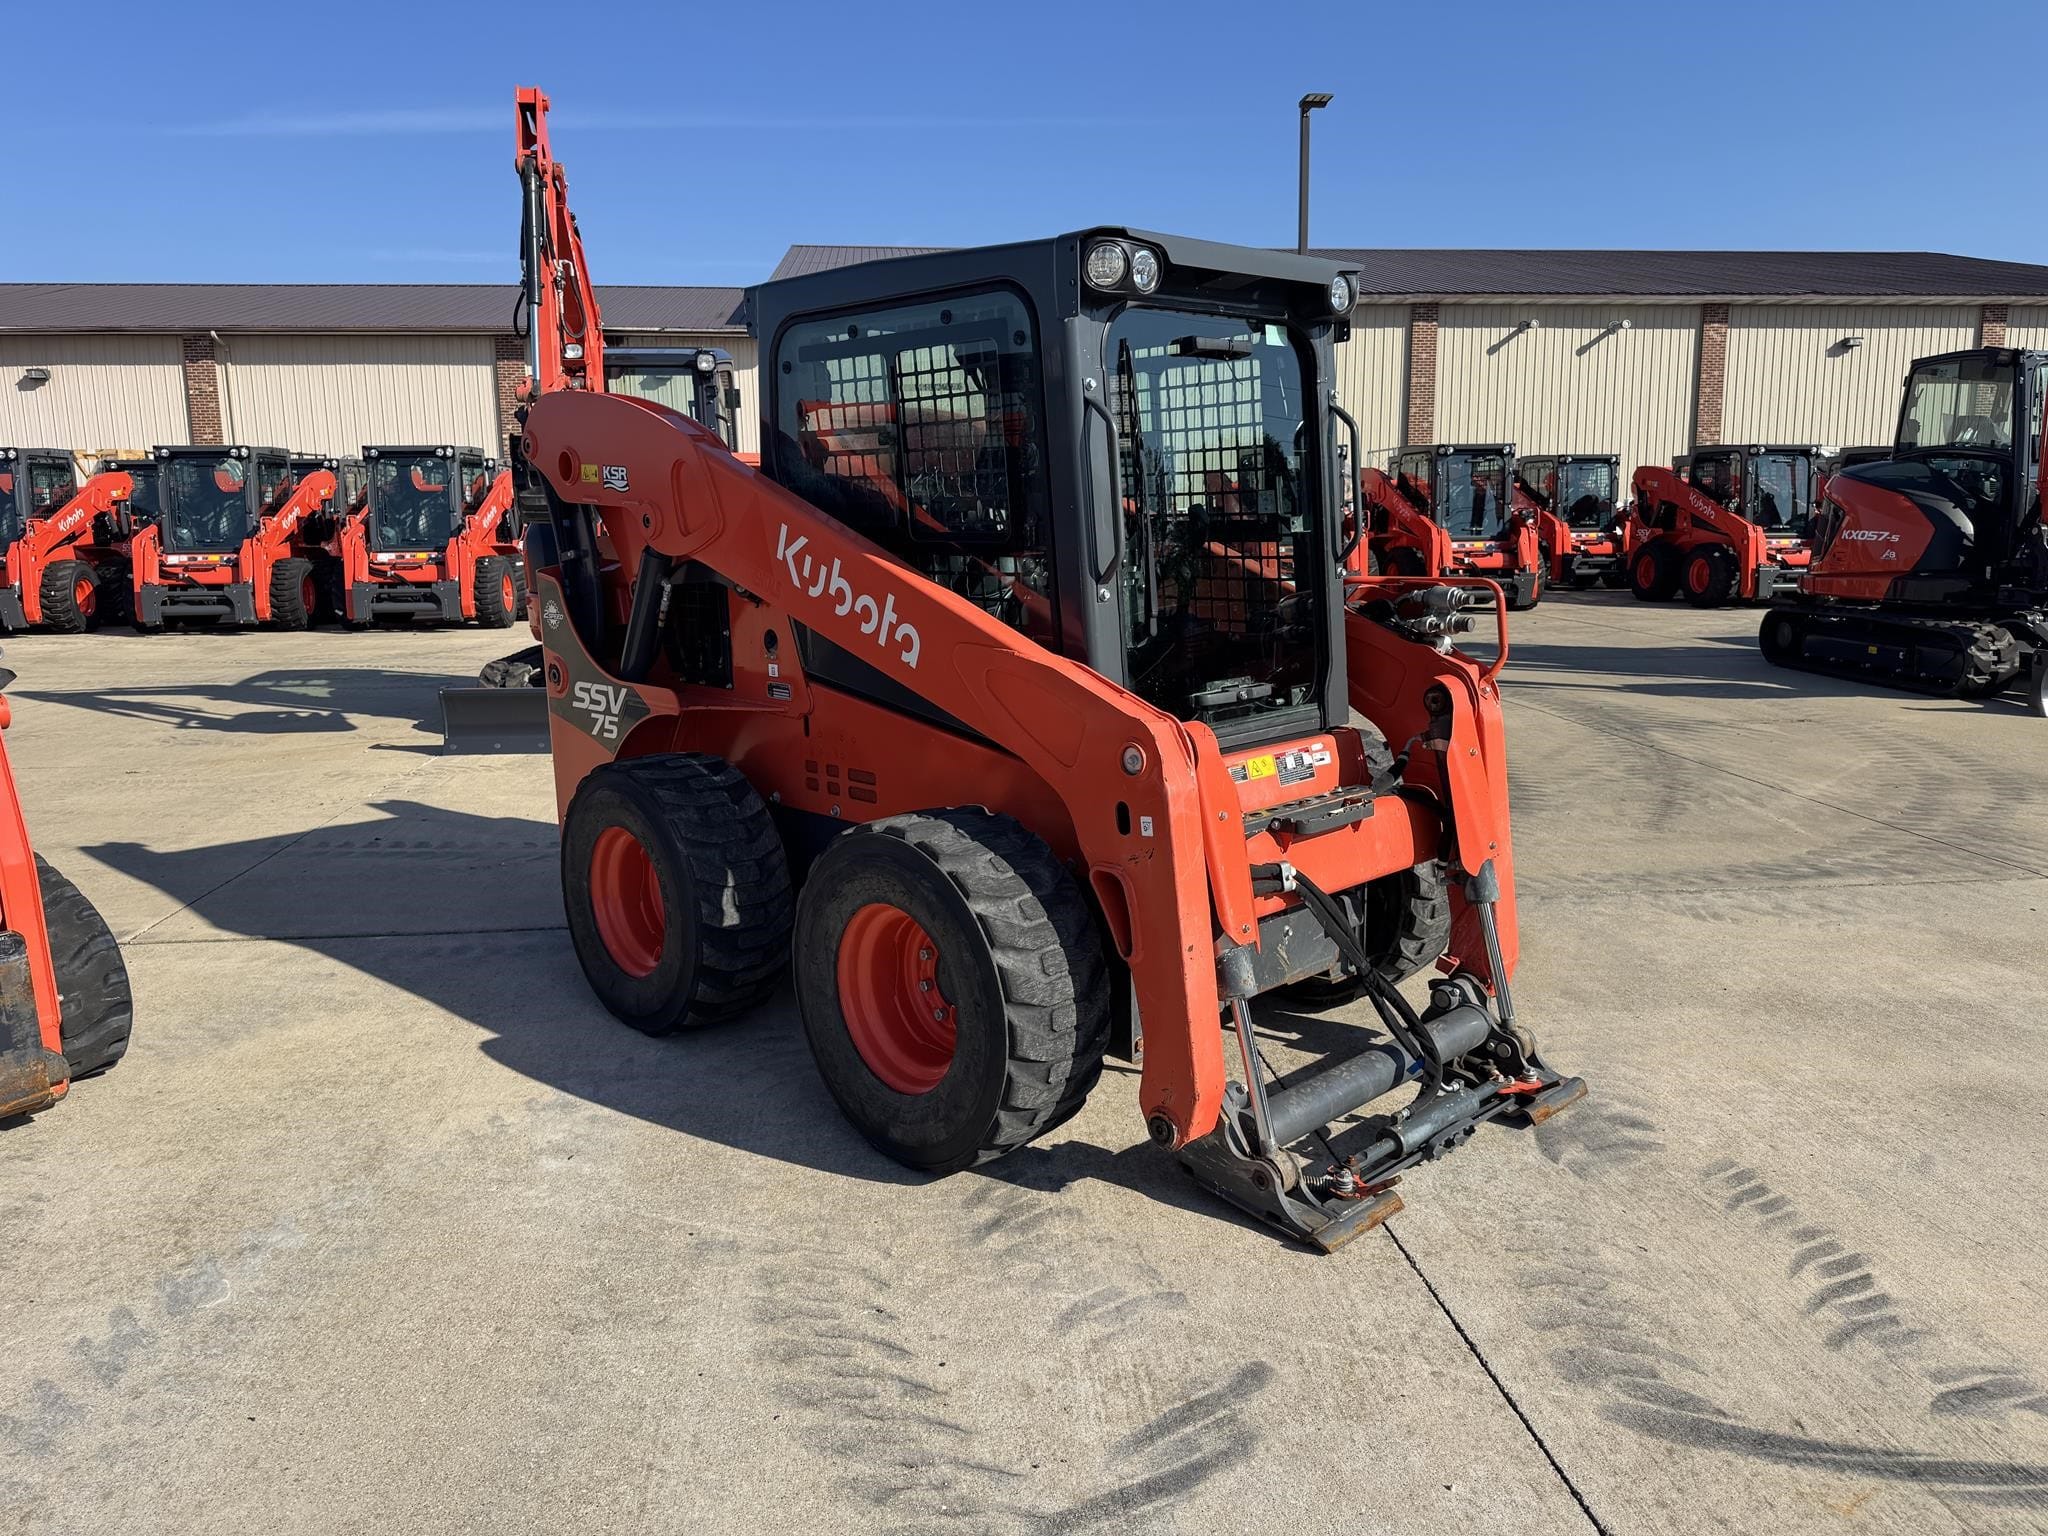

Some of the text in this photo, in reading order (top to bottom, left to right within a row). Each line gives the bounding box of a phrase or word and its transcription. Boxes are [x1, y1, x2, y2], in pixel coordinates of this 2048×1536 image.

[603, 465, 627, 480] KSR
[1688, 491, 1715, 519] Kubota
[58, 508, 84, 532] Kubota
[776, 522, 921, 670] Kubota
[572, 681, 627, 714] SSV
[591, 713, 619, 739] 75
